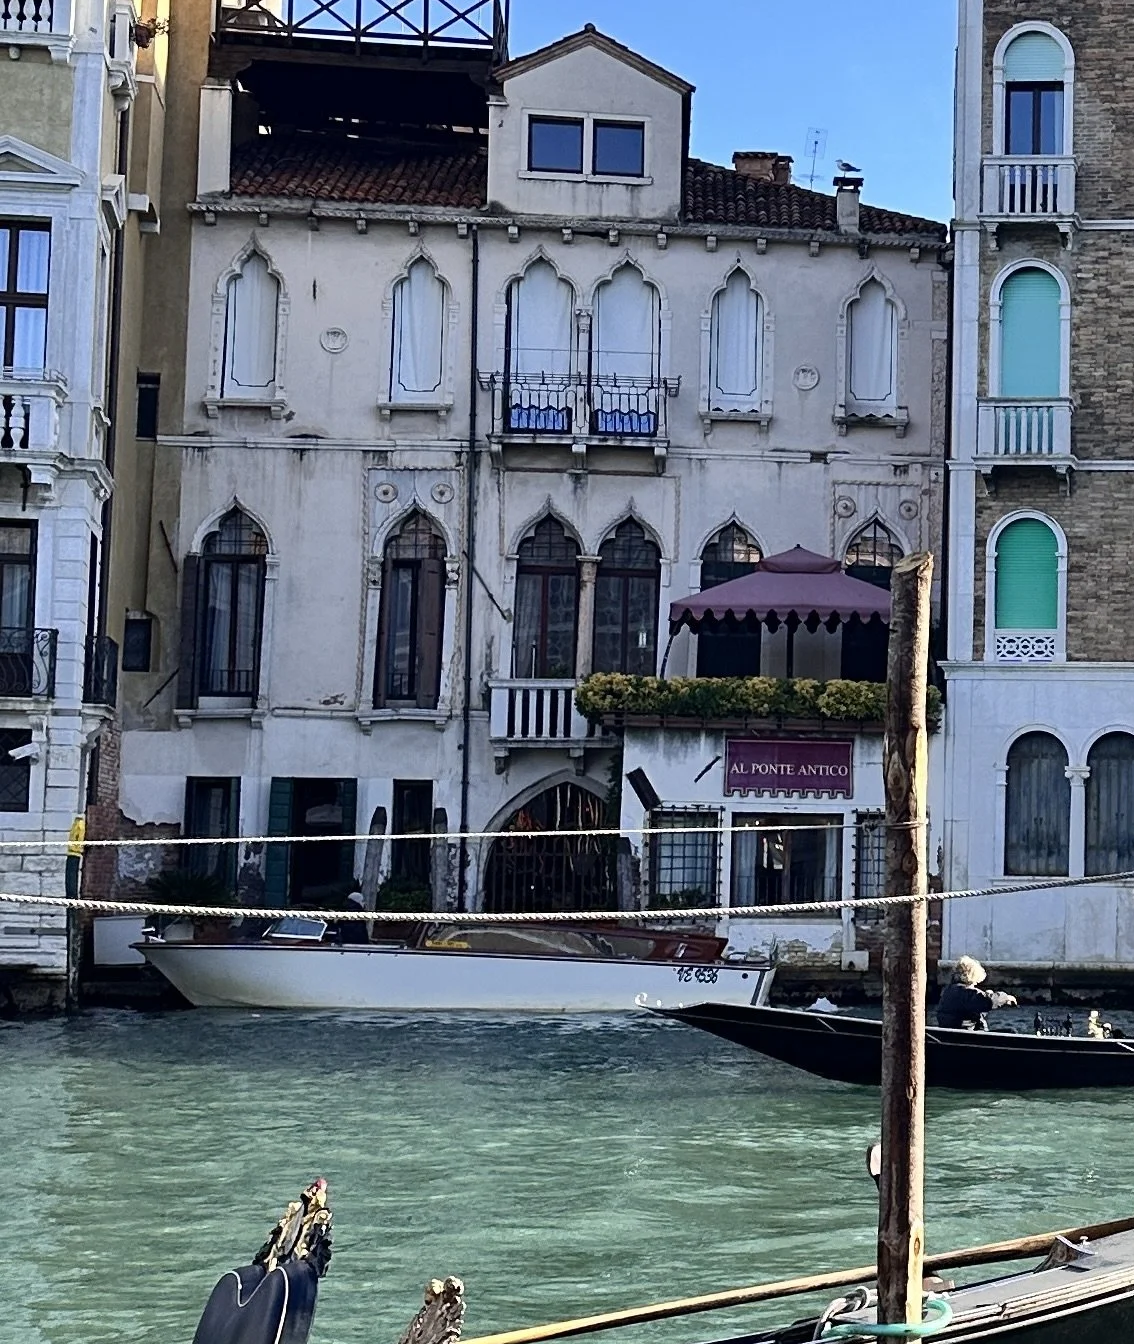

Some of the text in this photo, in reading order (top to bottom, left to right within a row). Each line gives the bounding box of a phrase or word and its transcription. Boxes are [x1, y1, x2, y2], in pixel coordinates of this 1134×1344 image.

[730, 763, 848, 776] AL PONTE ANTICO
